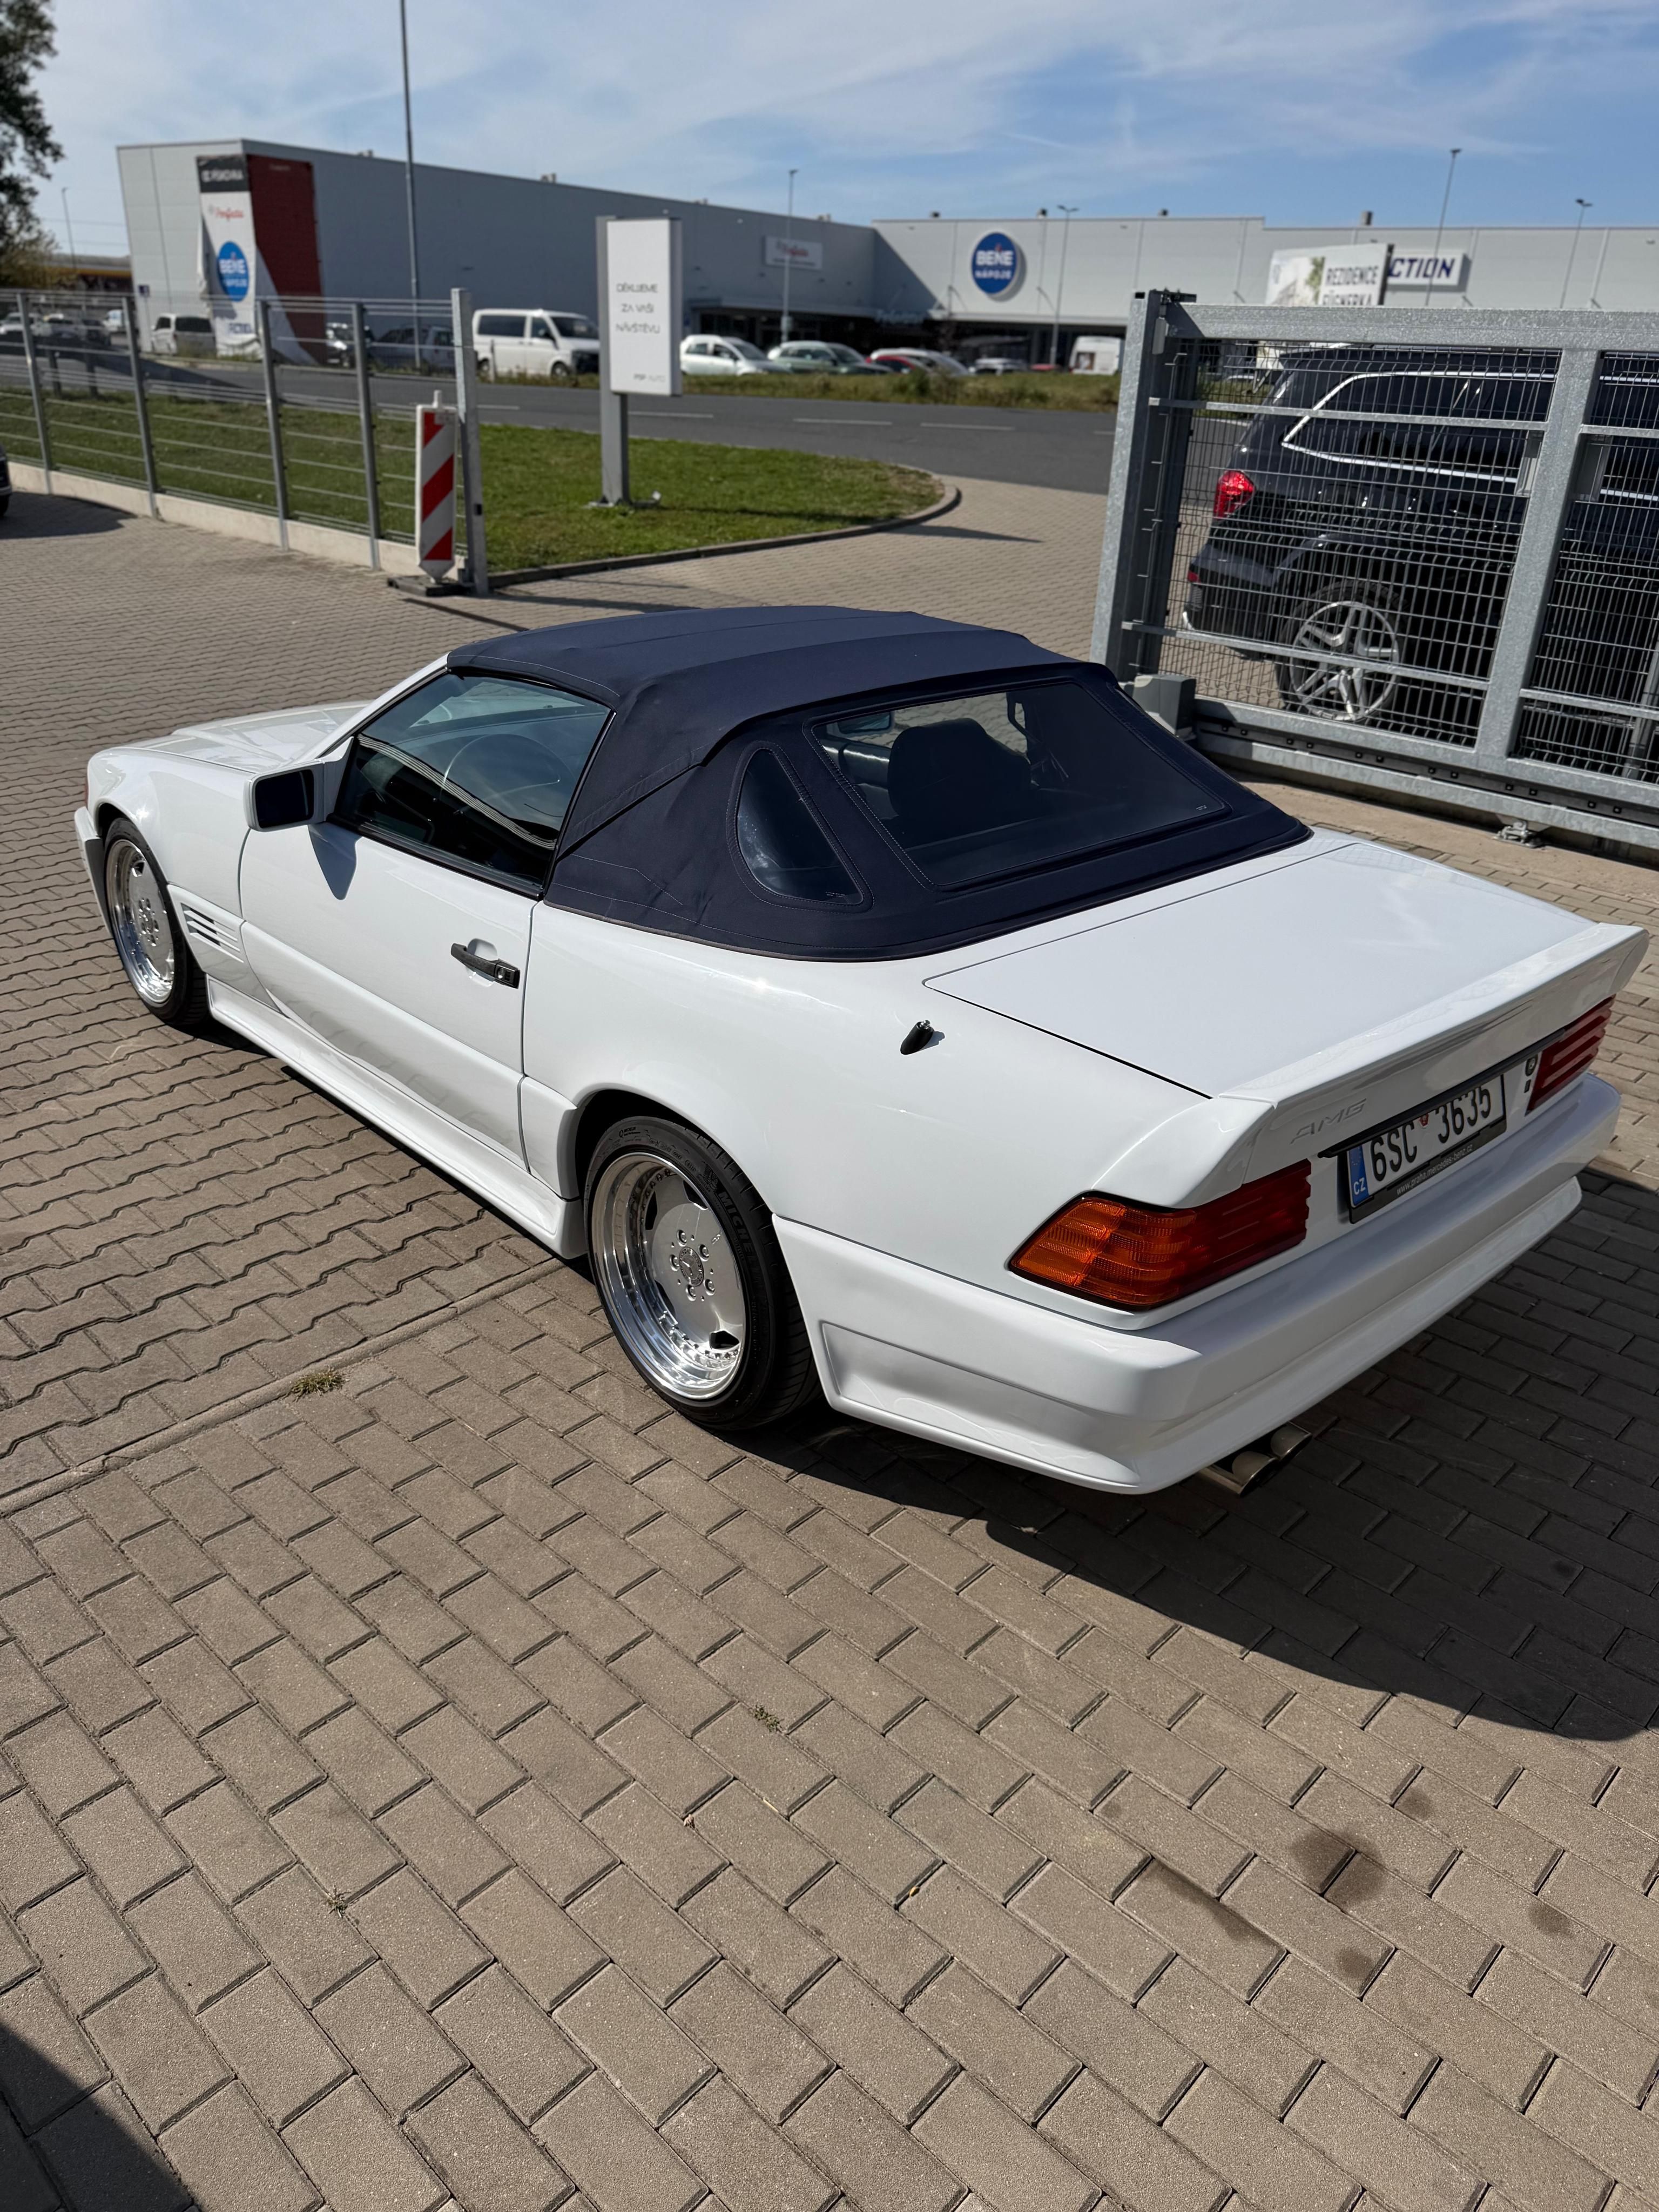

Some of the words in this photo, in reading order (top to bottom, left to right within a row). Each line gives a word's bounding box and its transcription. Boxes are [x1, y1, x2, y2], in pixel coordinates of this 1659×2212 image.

[976, 250, 1013, 266] BENE
[621, 303, 635, 313] ZA
[636, 302, 654, 313] VAŠI
[615, 321, 660, 334] NÁVŠTĚVU
[1290, 1098, 1367, 1144] AMG
[1370, 1120, 1417, 1182] 6SC
[1434, 1085, 1491, 1144] 3635
[1396, 1143, 1474, 1195] www.praha.mercedes-benz.cz
[1353, 1177, 1366, 1195] CZ
[717, 1190, 763, 1284] MICHELIN
